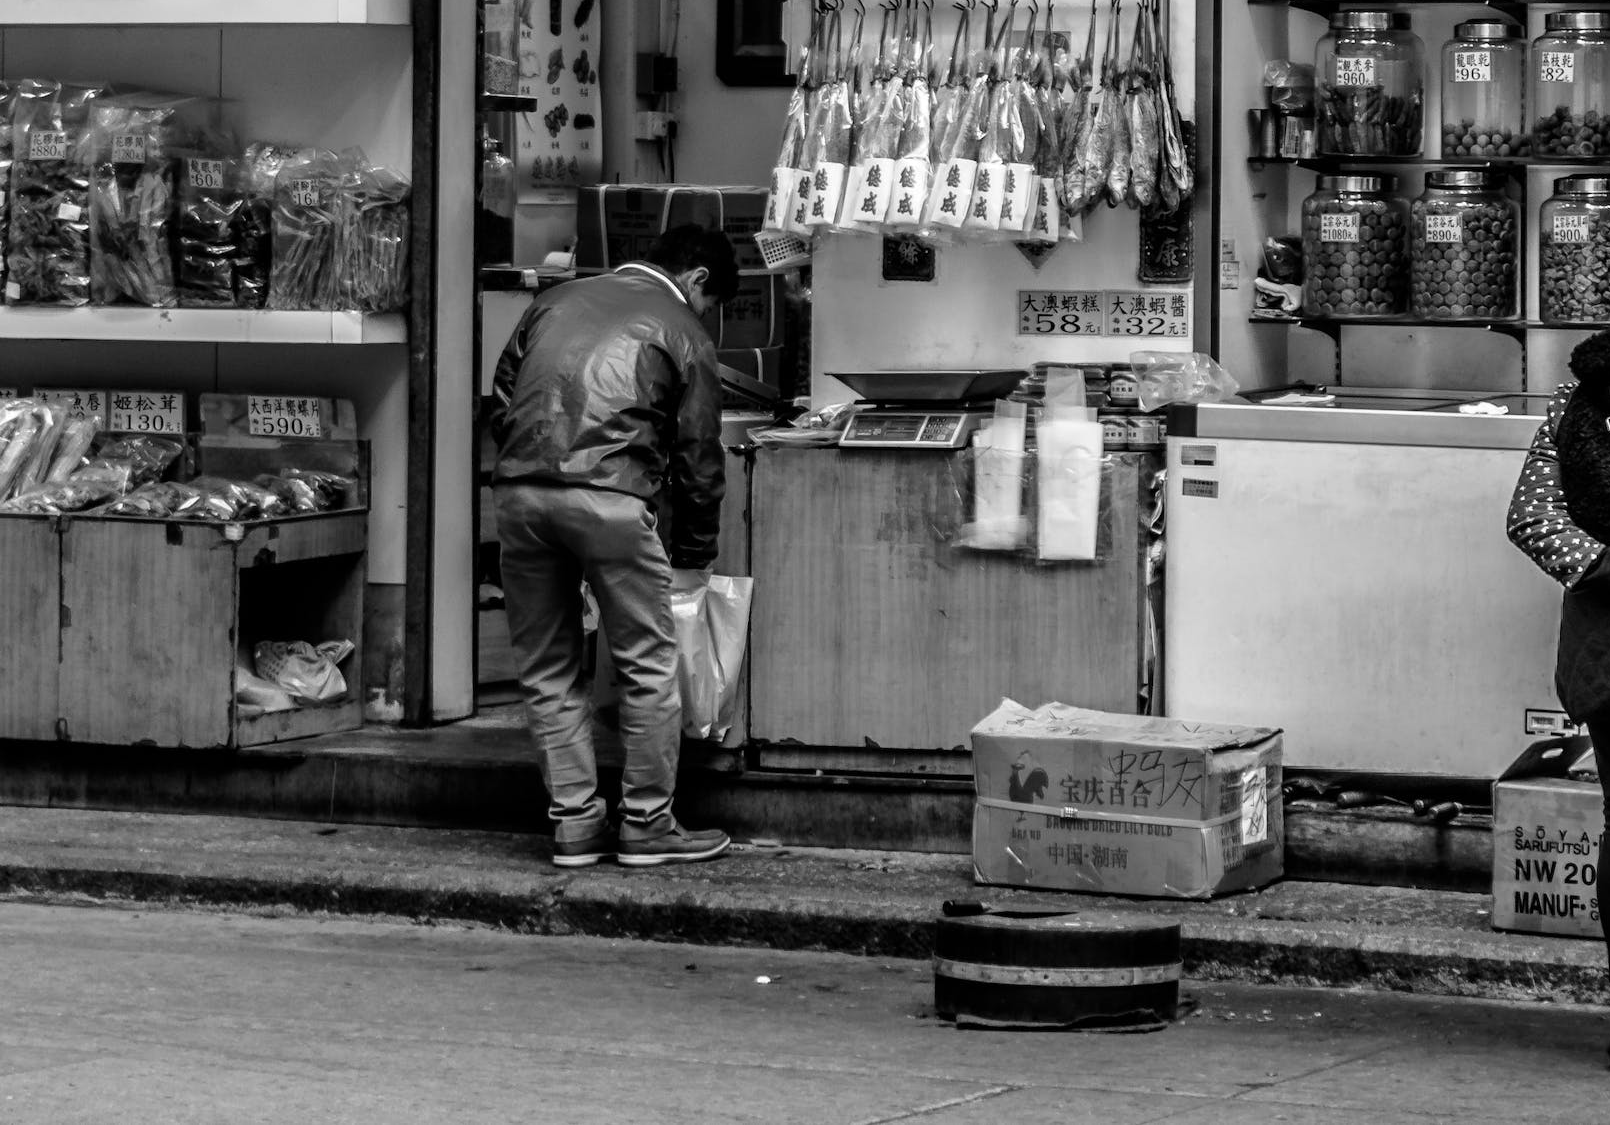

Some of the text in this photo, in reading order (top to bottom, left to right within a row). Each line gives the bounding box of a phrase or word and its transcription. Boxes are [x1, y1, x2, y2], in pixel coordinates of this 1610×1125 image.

[1343, 72, 1367, 86] 960
[1460, 67, 1482, 81] 96
[1545, 67, 1566, 81] 82
[35, 145, 58, 157] 880
[194, 173, 214, 187] 60
[1327, 228, 1349, 241] 1080
[1432, 229, 1453, 242] 890
[1559, 229, 1582, 242] 900
[1110, 294, 1186, 318] 大澳蝦醬
[1035, 313, 1082, 334] 58
[1126, 316, 1166, 336] 32
[112, 392, 178, 412] 姬松茸
[124, 413, 165, 431] 130
[262, 416, 304, 435] 590
[1059, 774, 1154, 809] 宝庆百合
[1514, 839, 1591, 857] SARUFUTSU
[1514, 858, 1557, 883] NW
